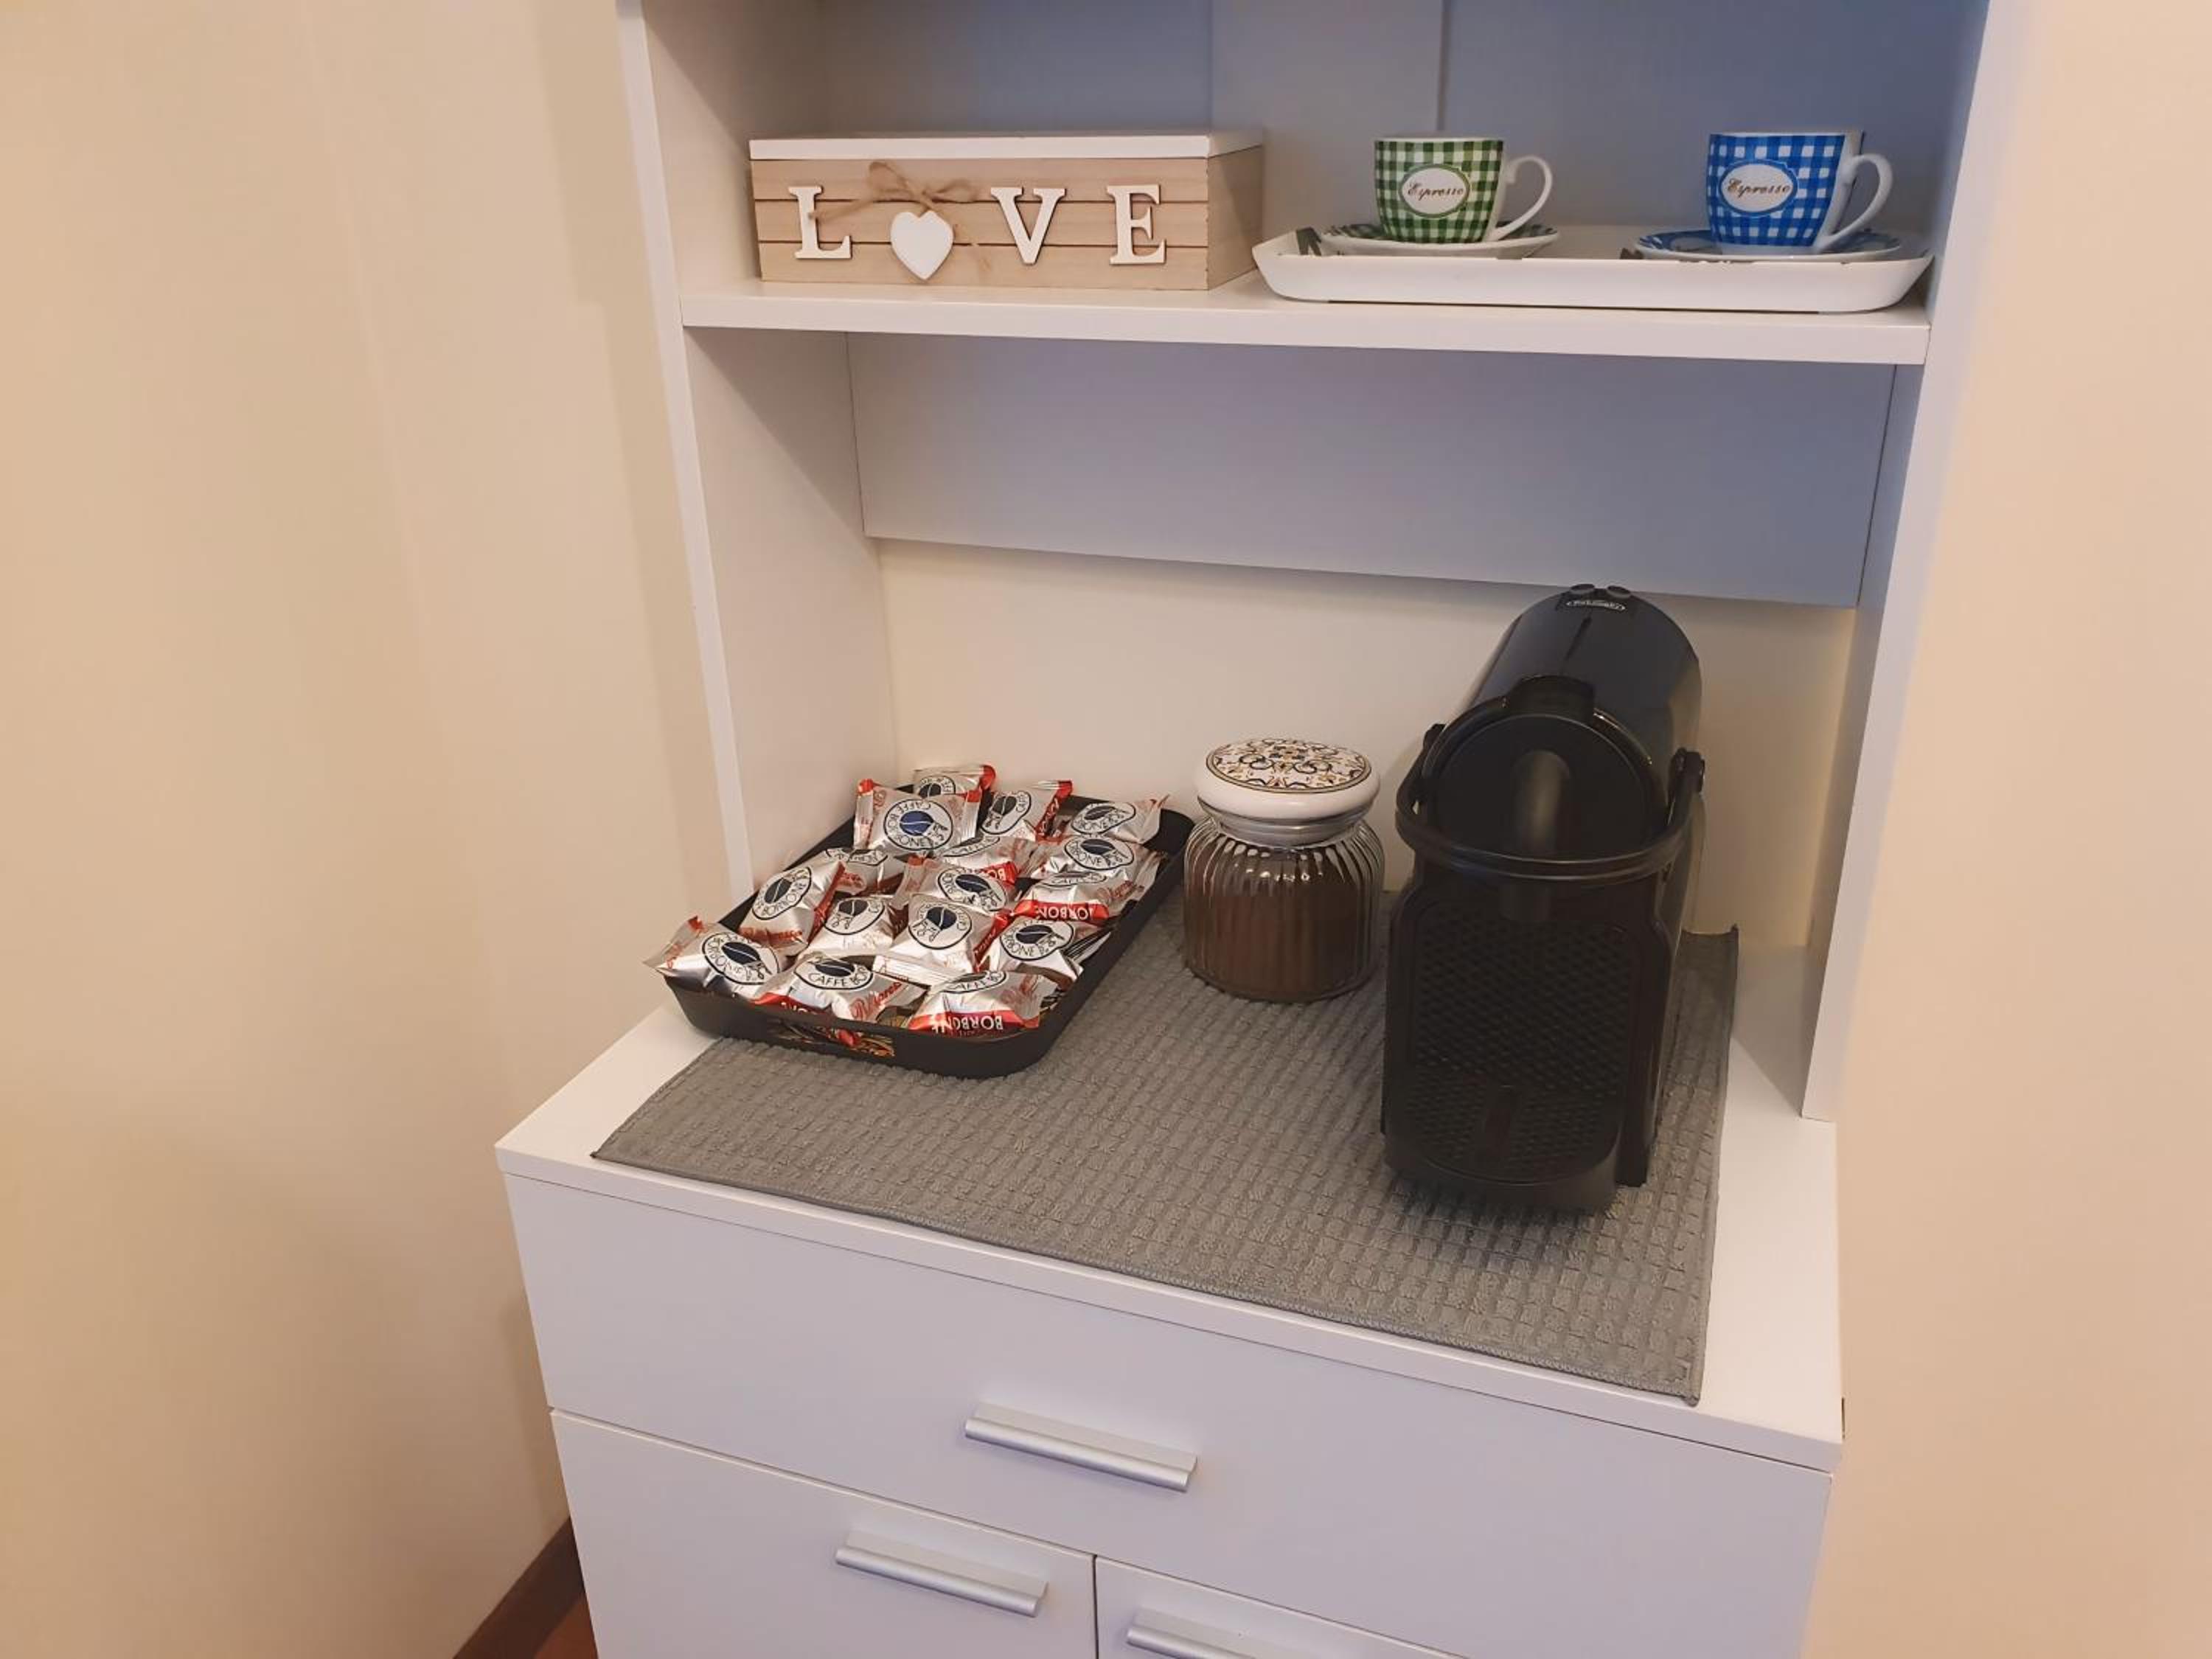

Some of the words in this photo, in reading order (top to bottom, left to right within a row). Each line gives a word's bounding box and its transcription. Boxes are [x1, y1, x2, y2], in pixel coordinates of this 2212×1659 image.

[1408, 181, 1464, 201] Espresso
[1728, 178, 1792, 198] Espresso
[1037, 902, 1094, 920] ORBON
[931, 1015, 1004, 1034] BORBONE
